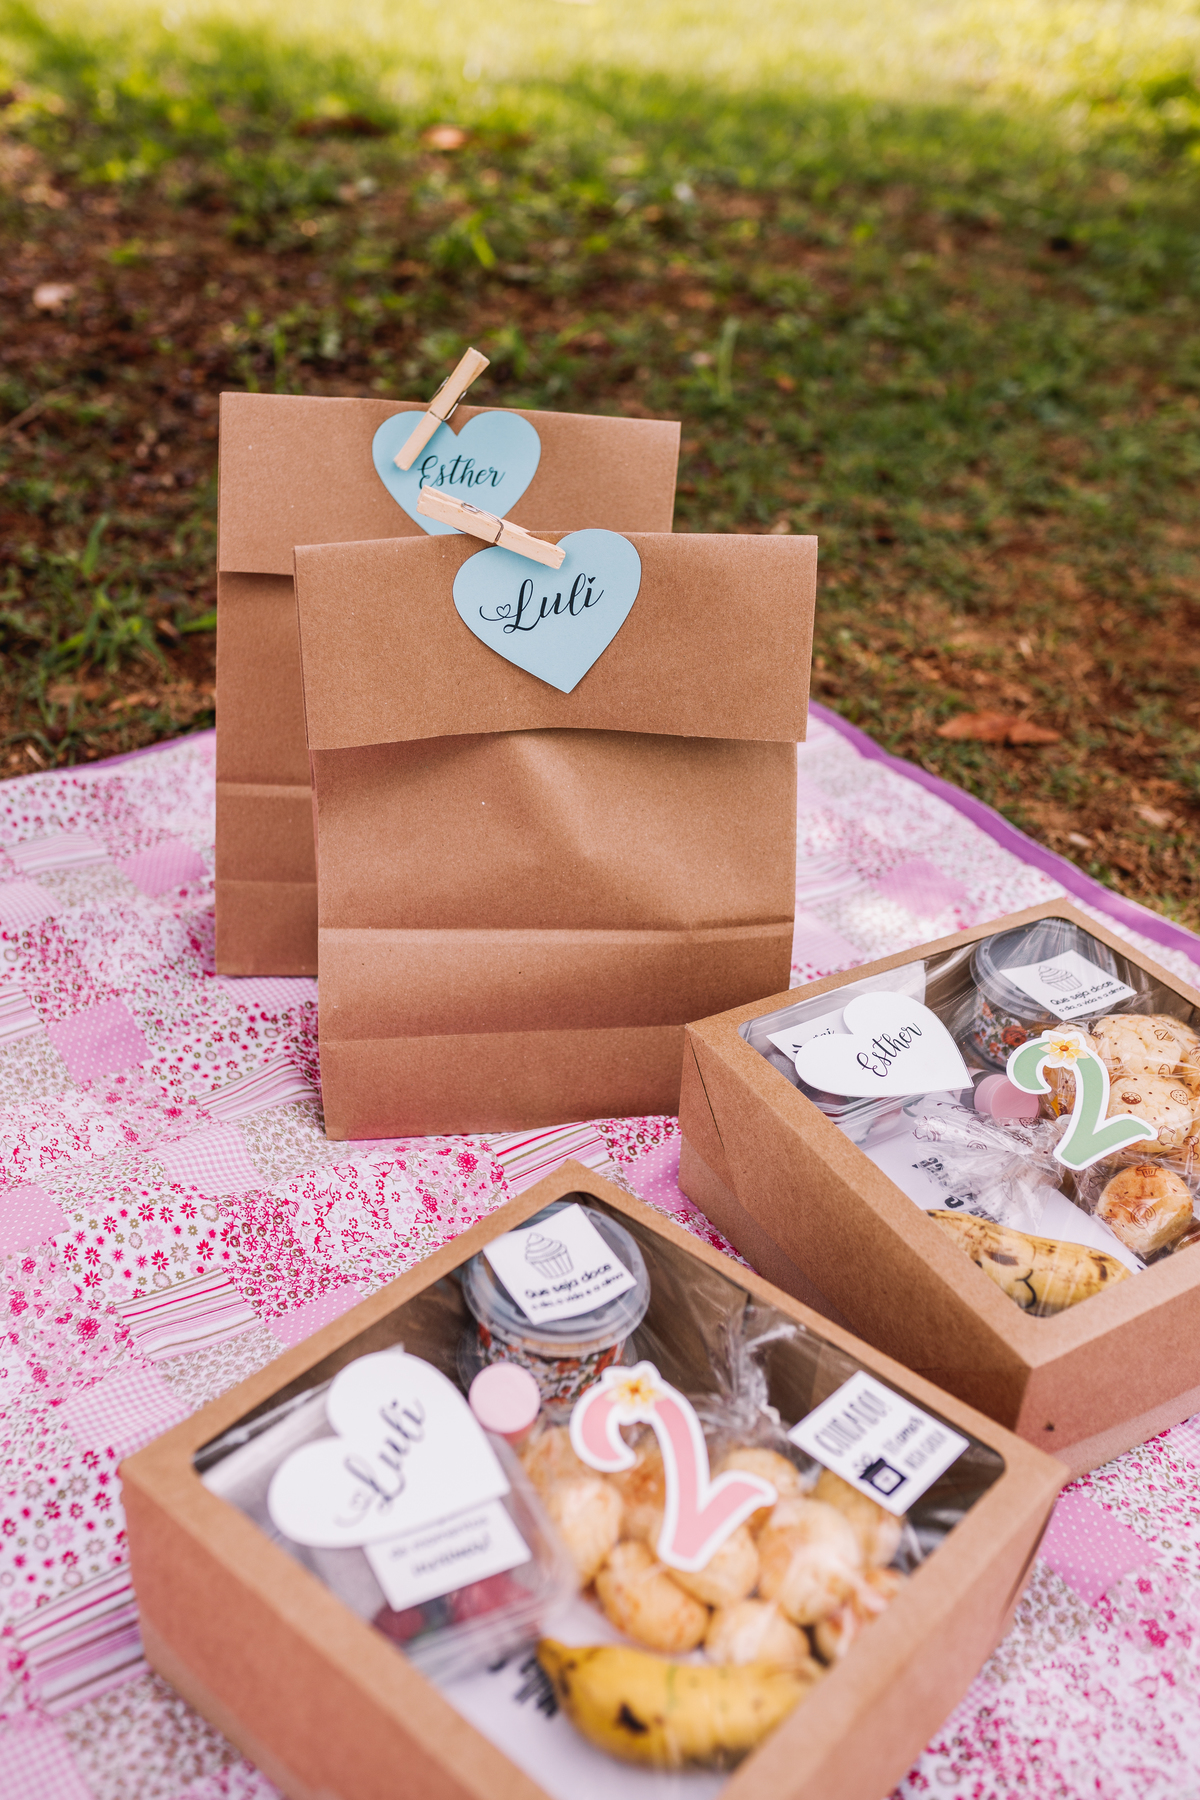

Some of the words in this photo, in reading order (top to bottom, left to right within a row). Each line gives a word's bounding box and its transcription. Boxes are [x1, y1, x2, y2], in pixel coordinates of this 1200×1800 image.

[417, 454, 506, 490] Esther
[479, 572, 605, 634] Luli
[1050, 997, 1070, 1006] Que
[1090, 981, 1114, 993] doce
[856, 1022, 923, 1078] Esther
[1009, 1034, 1155, 1168] 2
[581, 1264, 612, 1283] doce
[334, 1398, 426, 1528] Luli
[574, 1370, 772, 1566] 2
